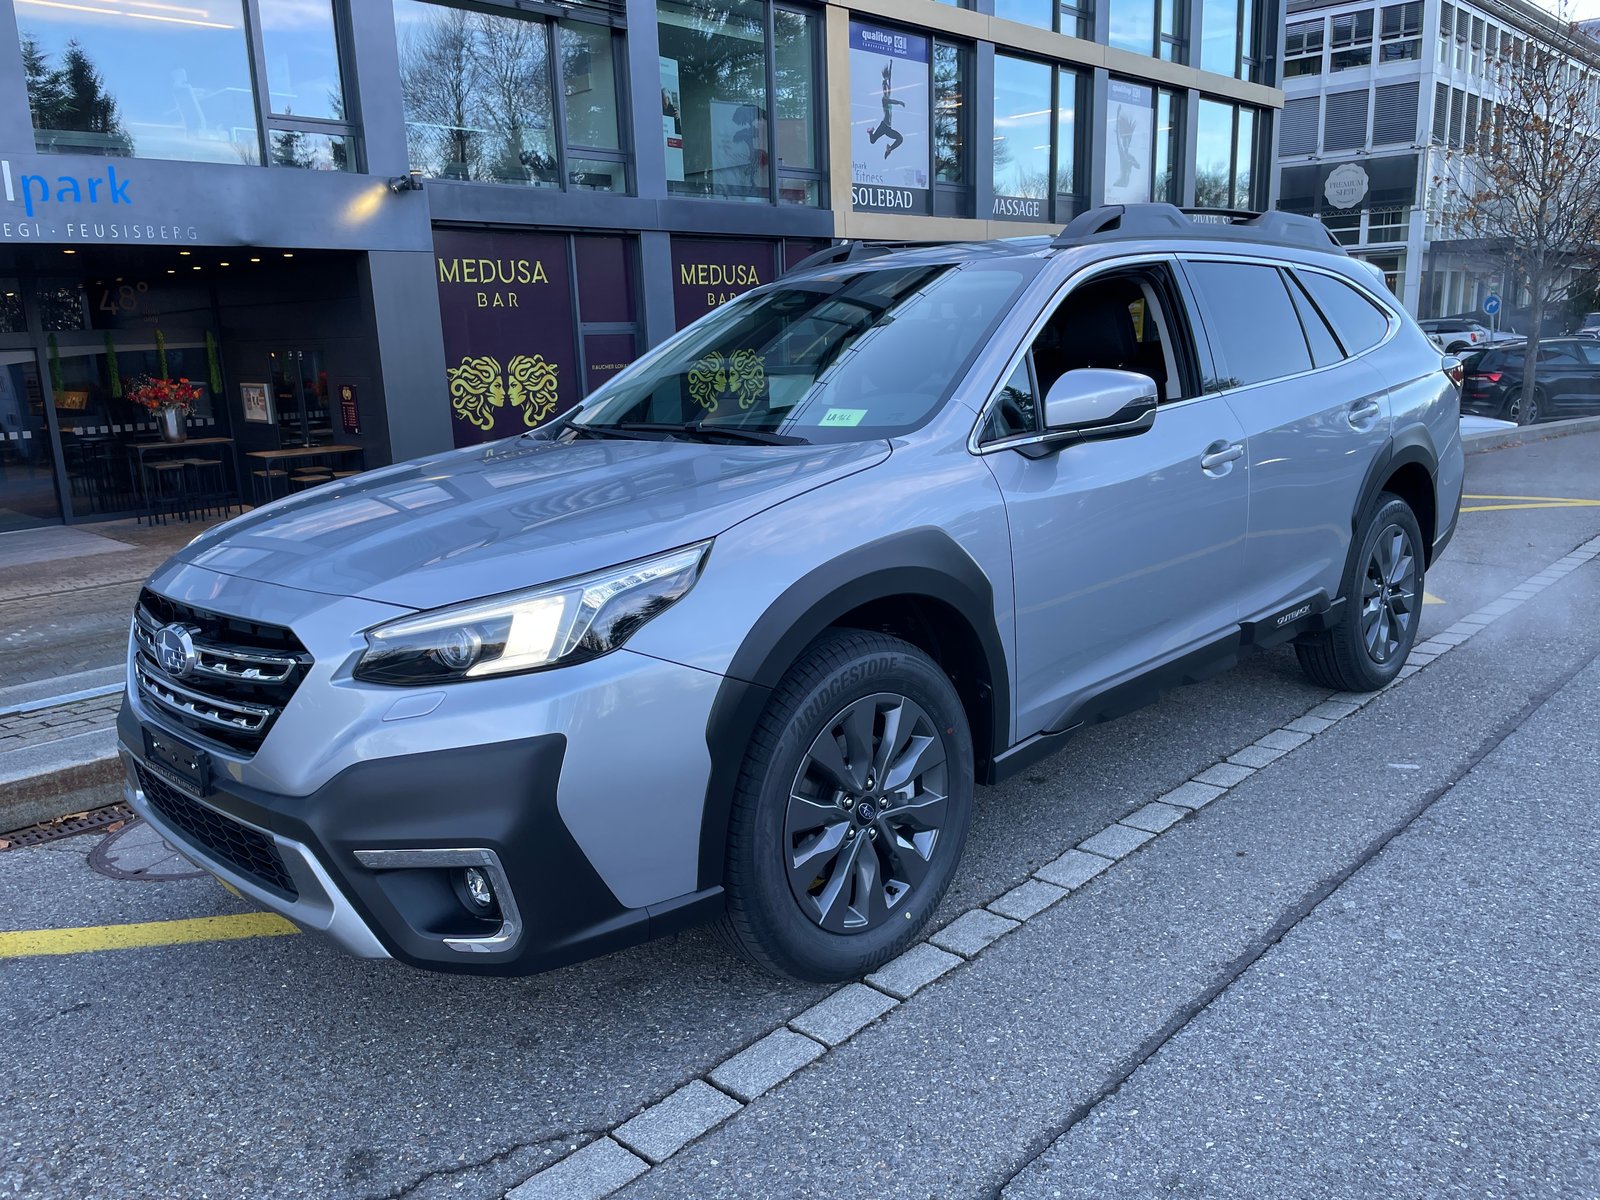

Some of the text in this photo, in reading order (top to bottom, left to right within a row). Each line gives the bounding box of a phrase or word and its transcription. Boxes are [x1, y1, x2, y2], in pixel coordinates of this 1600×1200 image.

[862, 30, 893, 45] qualitop
[855, 169, 884, 183] fitness
[851, 186, 913, 209] SOLEBAD
[3, 223, 198, 240] EGI FEUSISBERG
[438, 258, 549, 284] MEDUSA
[680, 263, 760, 286] MEDUSA
[477, 292, 519, 308] BAR
[790, 656, 898, 743] BRIDGESTONE
